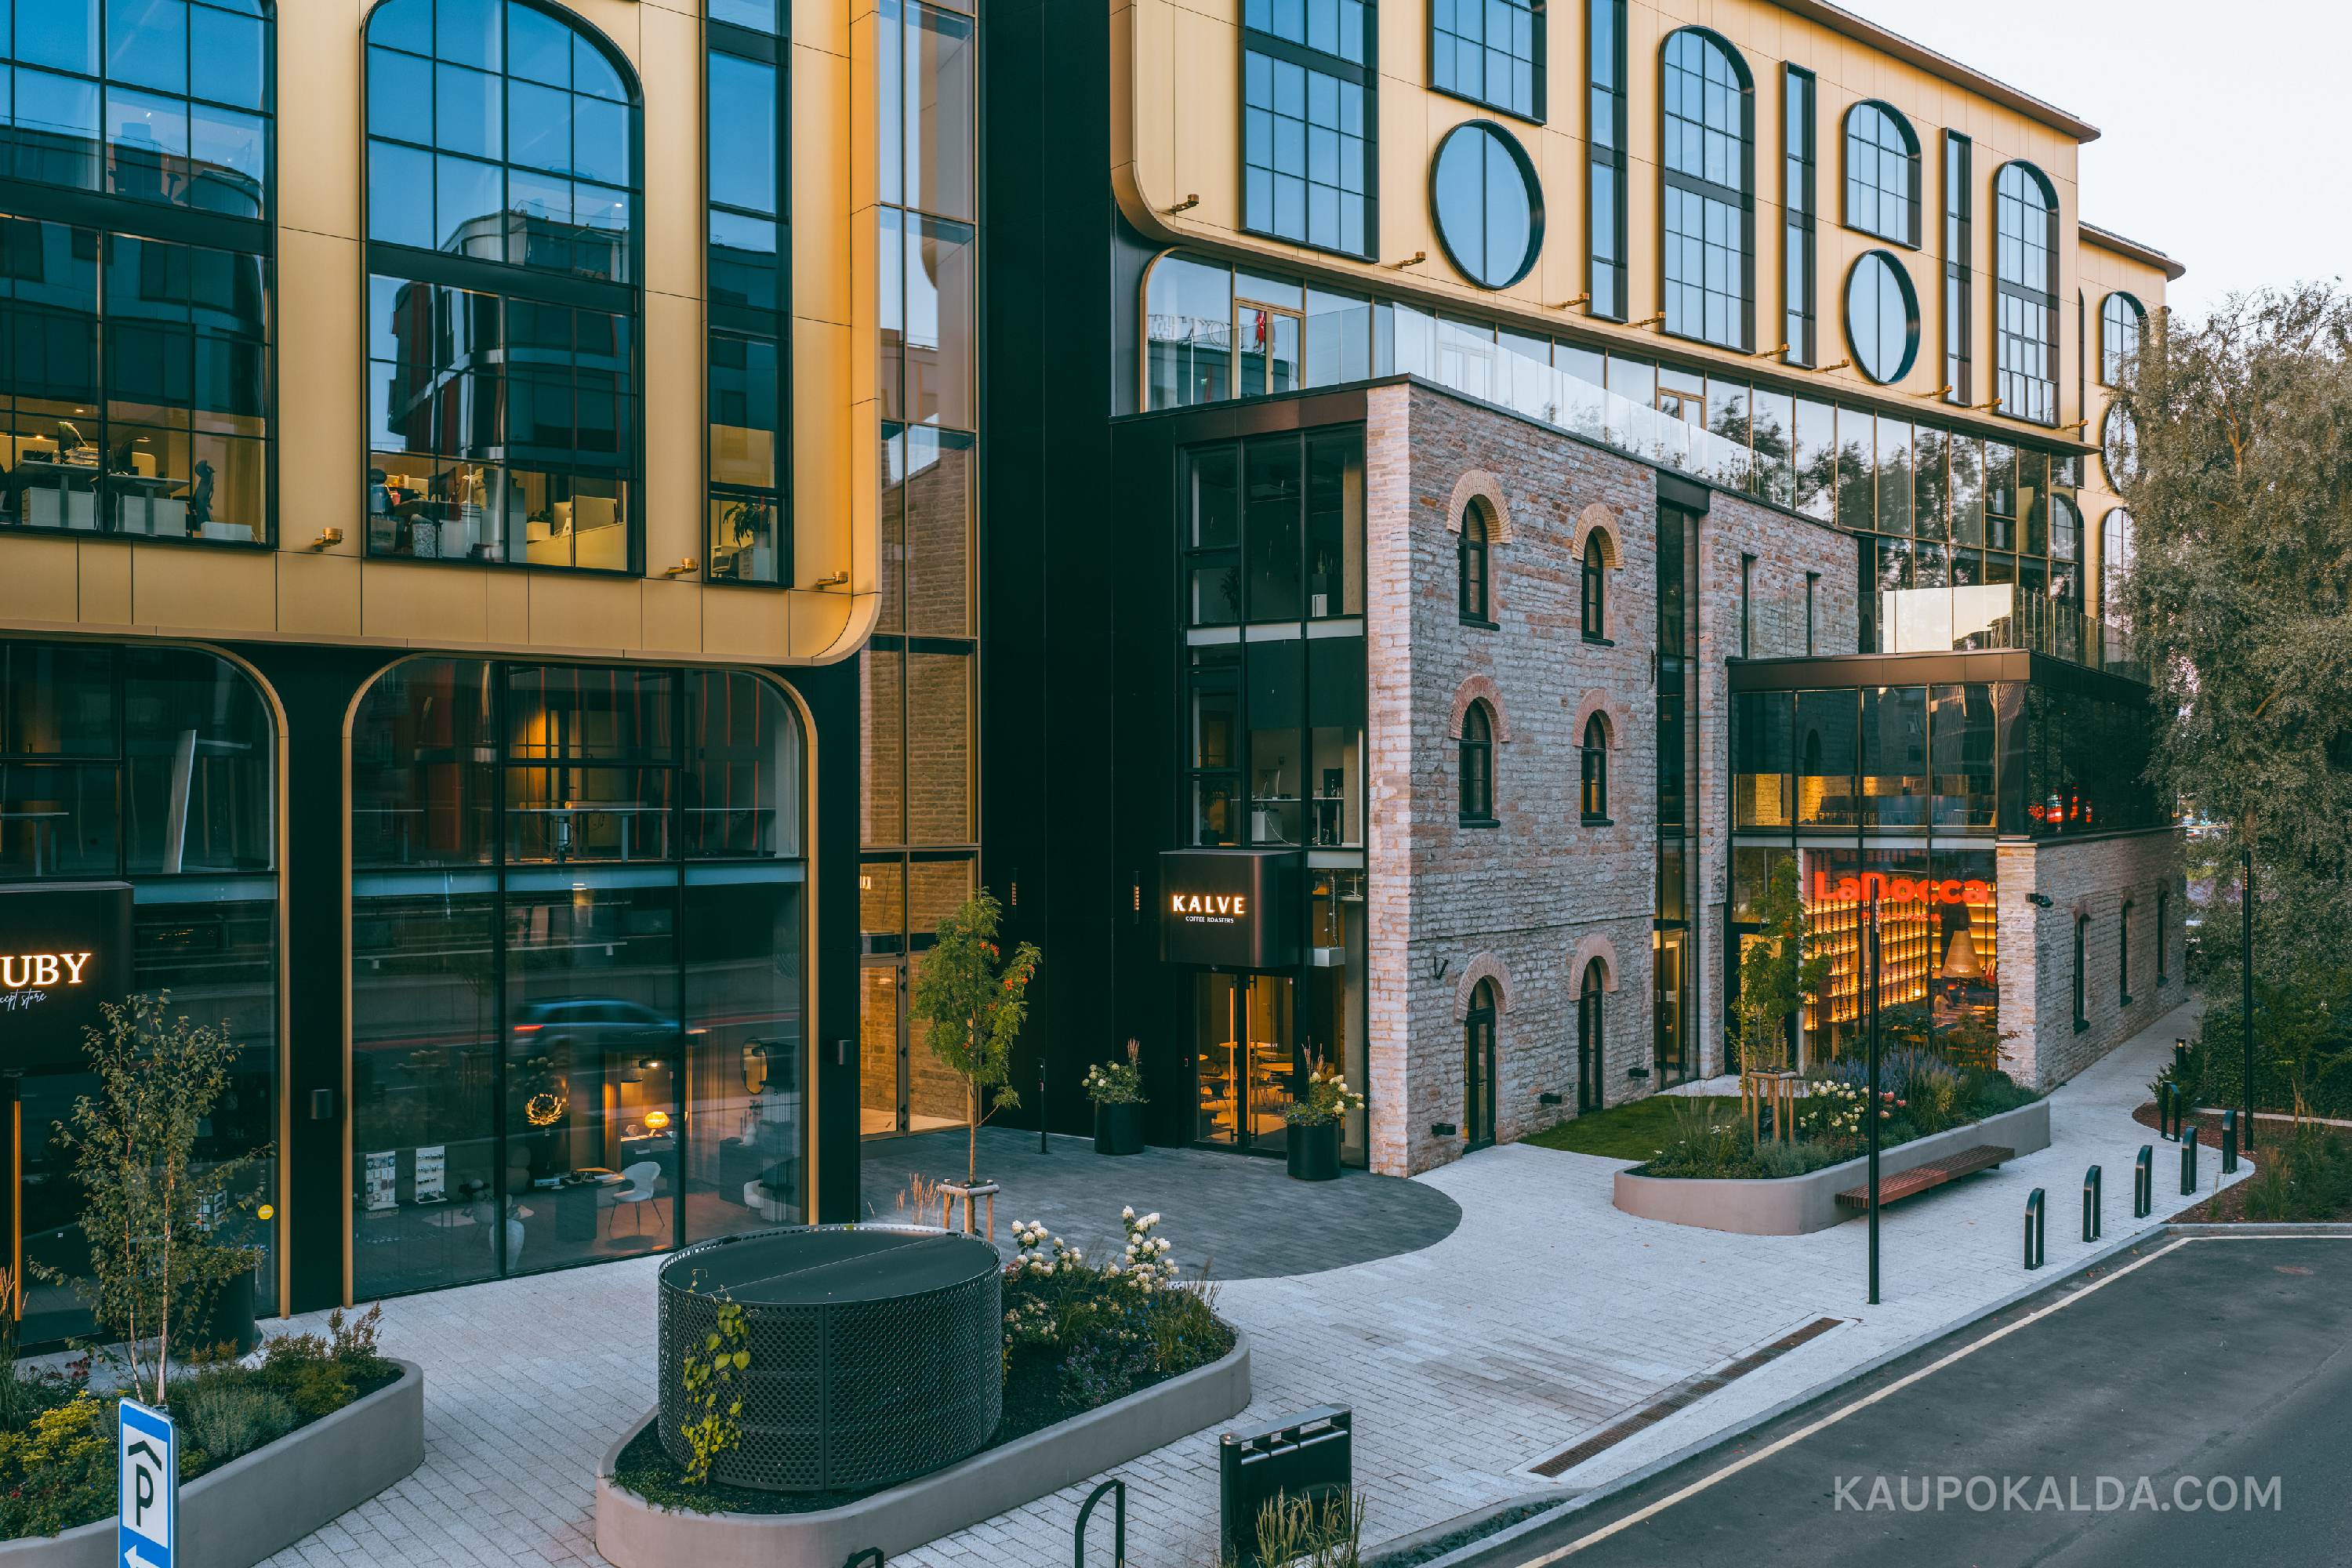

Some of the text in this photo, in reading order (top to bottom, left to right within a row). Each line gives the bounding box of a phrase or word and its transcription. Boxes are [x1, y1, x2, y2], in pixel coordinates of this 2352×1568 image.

[1173, 895, 1245, 914] KALVE
[21, 987, 47, 1010] store
[136, 1463, 154, 1528] P
